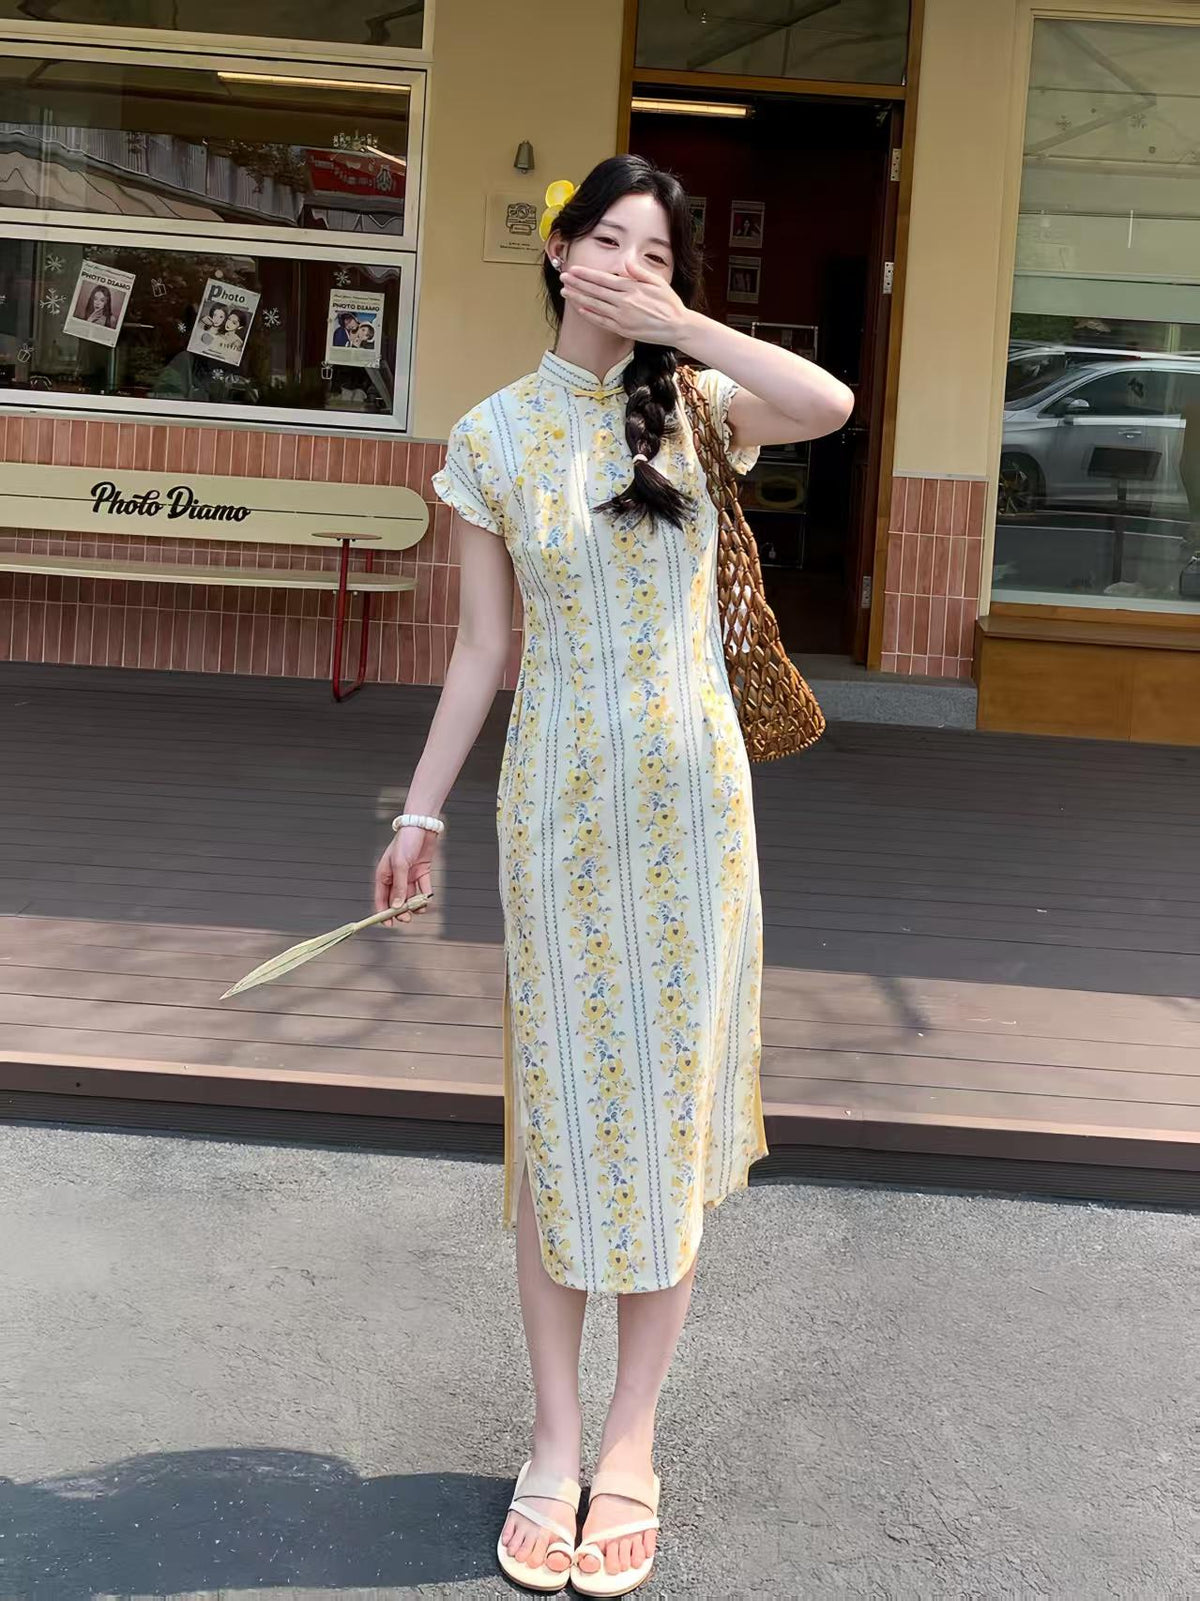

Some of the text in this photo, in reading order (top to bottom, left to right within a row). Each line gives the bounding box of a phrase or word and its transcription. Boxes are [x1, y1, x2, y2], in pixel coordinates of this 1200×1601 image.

[81, 271, 106, 284] PHOTO
[107, 278, 131, 291] DIAMO
[332, 302, 356, 310] PHOTO
[90, 481, 251, 522] Photo Diamo
